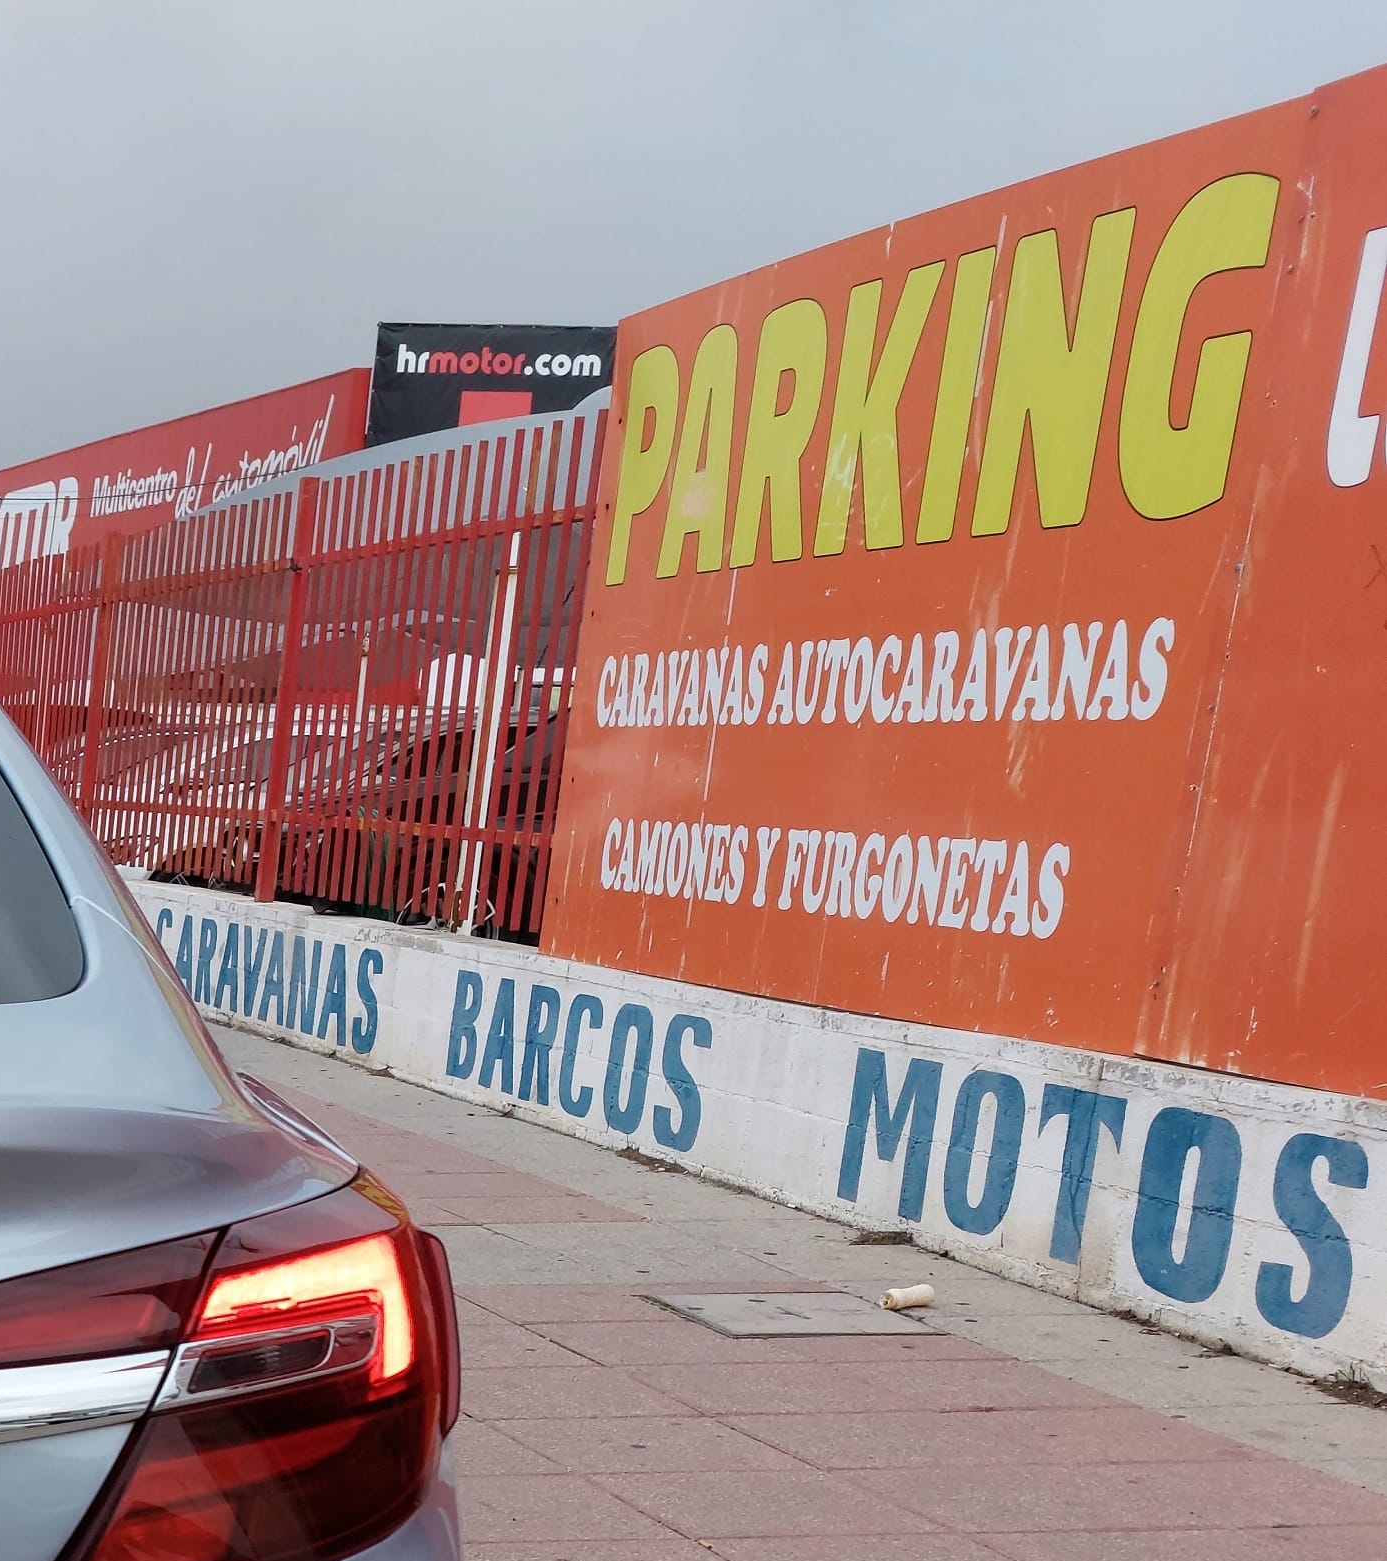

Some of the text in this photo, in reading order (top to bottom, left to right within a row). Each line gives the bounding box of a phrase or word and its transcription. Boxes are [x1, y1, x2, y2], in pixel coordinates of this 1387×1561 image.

[396, 343, 602, 377] hrmotor.com
[604, 170, 1281, 588] PARKING
[89, 463, 179, 519] Multicentro
[174, 442, 213, 520] del
[596, 615, 1177, 729] CARAVANAS AUTOCARAVANAS
[599, 816, 1072, 941] CAMIONES Y FURGONETAS
[444, 968, 714, 1154] BARCOS
[835, 1045, 1370, 1342] MOTOS
